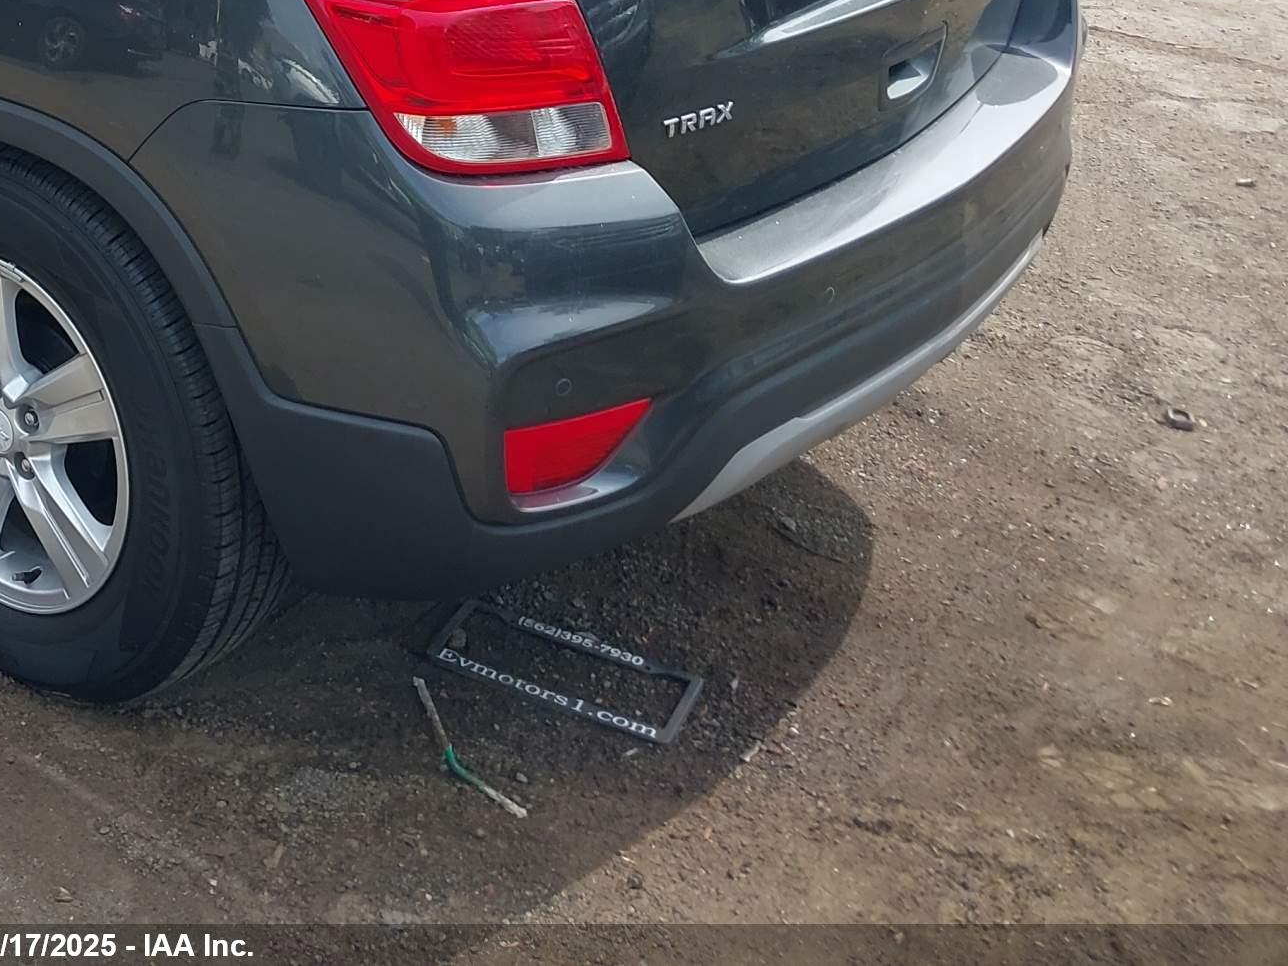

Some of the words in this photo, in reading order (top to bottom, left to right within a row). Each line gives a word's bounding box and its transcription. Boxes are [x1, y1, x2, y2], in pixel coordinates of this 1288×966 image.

[663, 101, 734, 138] TRAX
[517, 616, 645, 666] (562)395-7930
[438, 647, 657, 739] Evmotors1.com
